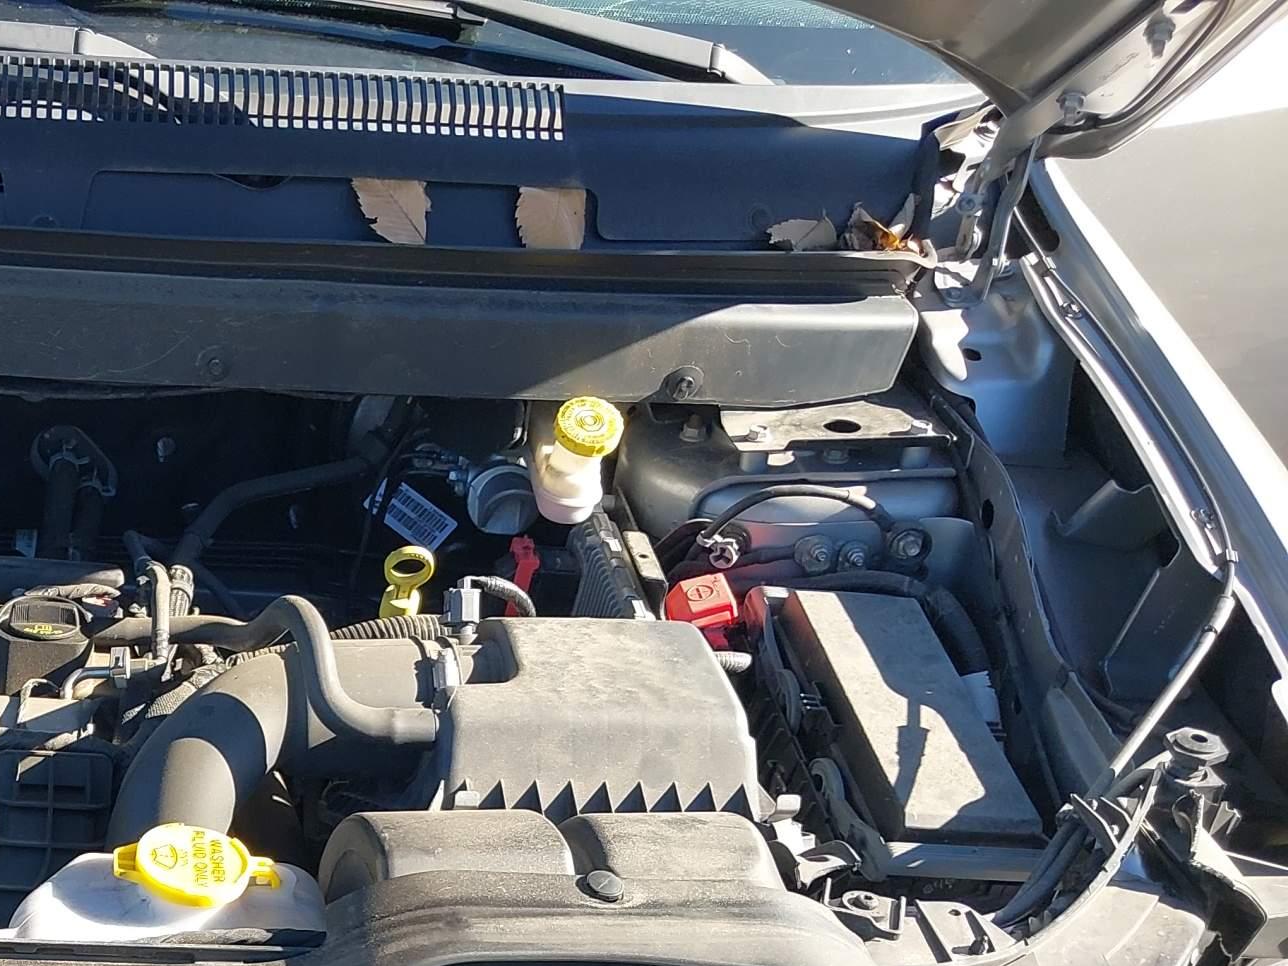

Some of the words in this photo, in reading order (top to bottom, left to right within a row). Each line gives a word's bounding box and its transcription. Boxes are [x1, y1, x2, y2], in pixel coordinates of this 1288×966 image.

[193, 831, 207, 858] FLUID
[210, 840, 226, 882] WASHER
[194, 863, 208, 887] ONLY
